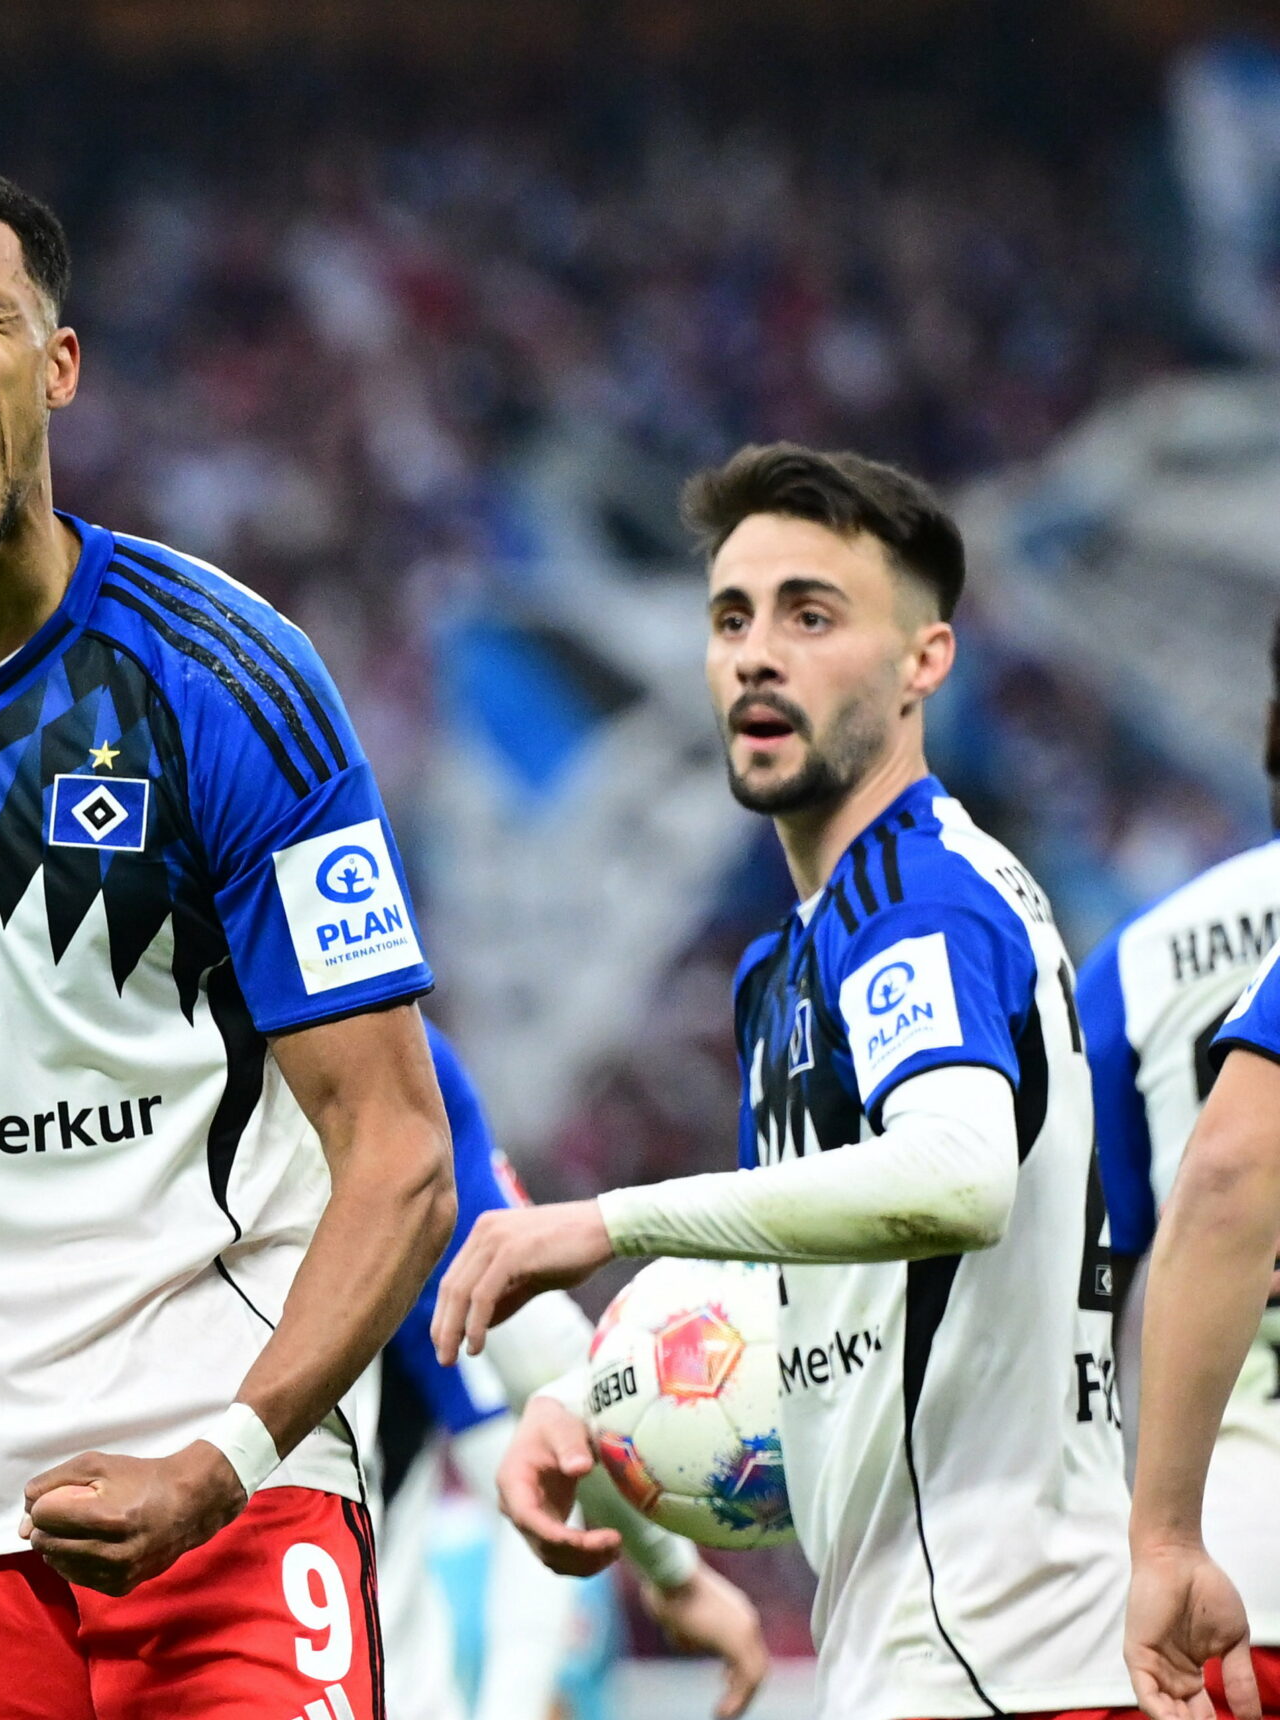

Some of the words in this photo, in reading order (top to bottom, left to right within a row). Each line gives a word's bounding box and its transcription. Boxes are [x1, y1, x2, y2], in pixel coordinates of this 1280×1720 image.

[316, 904, 404, 952] PLAN
[324, 936, 409, 967] INTERNATIONAL
[1171, 910, 1280, 981] HAM
[868, 1001, 934, 1060] PLAN
[588, 1365, 638, 1415] DERB
[282, 1542, 353, 1681] 9
